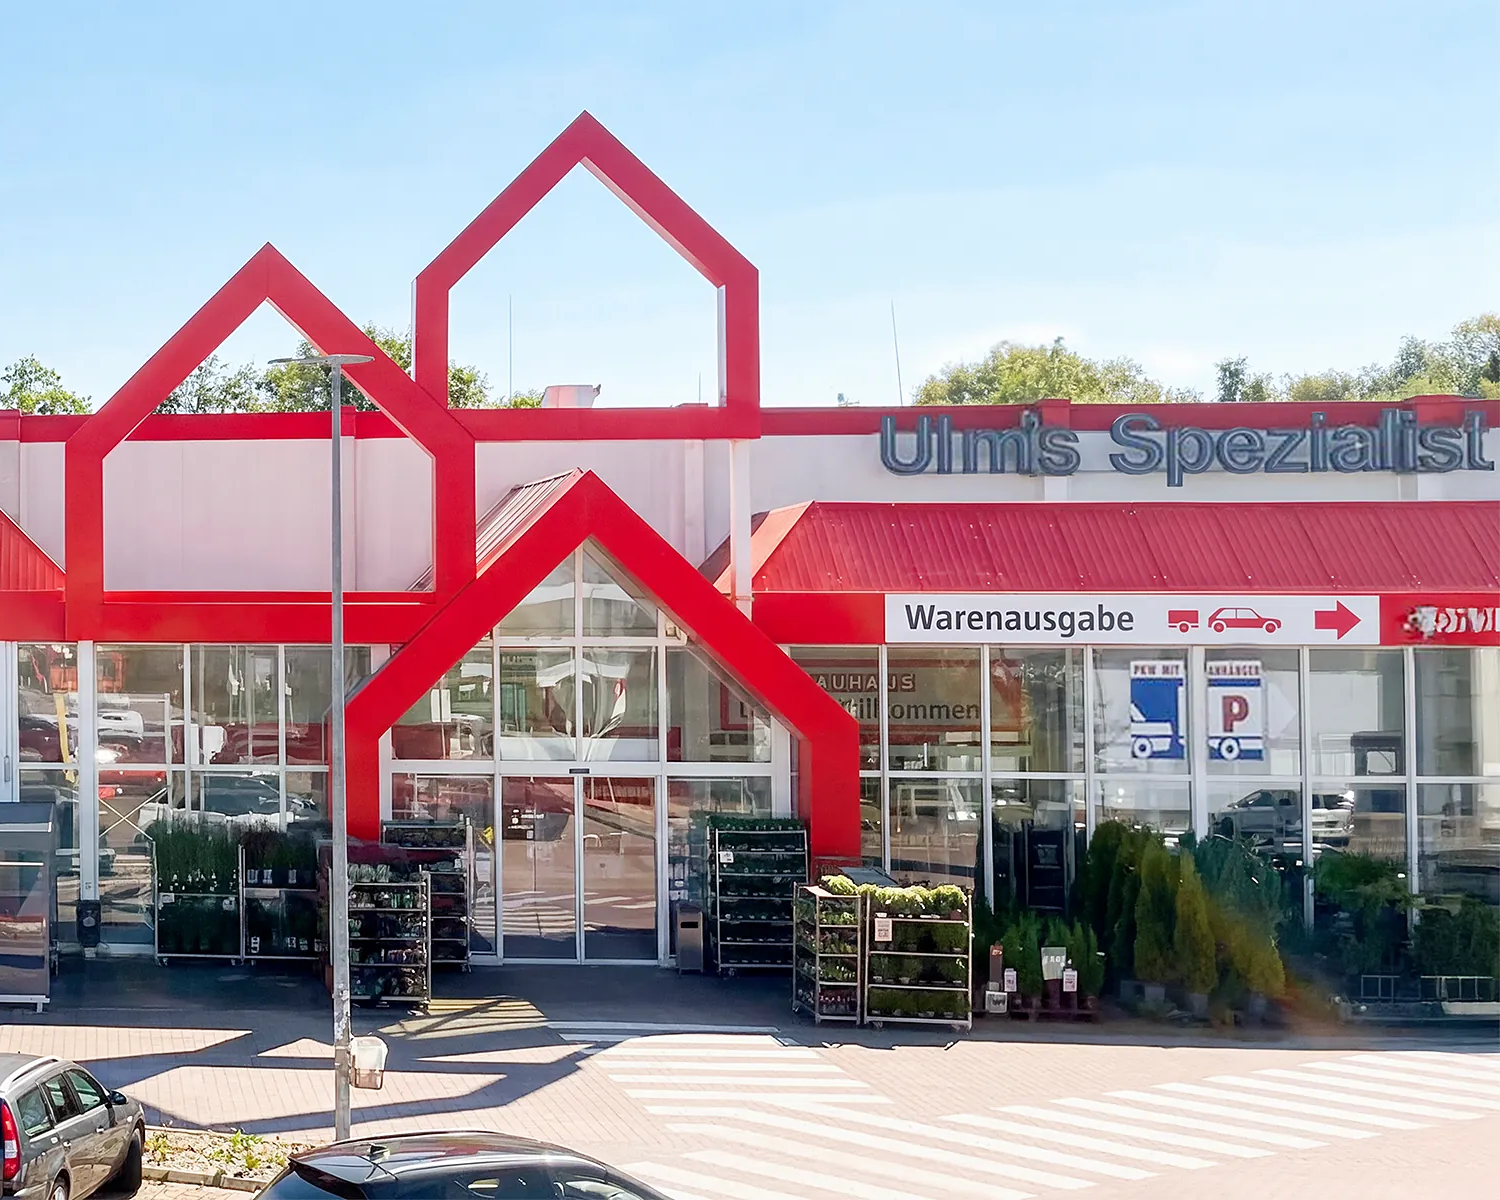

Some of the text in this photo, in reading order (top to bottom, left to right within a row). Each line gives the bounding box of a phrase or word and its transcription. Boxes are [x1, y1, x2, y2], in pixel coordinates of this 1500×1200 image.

[880, 407, 1494, 487] Ulm's Spezialist
[904, 603, 1134, 638] Warenausgabe
[1223, 694, 1249, 733] P
